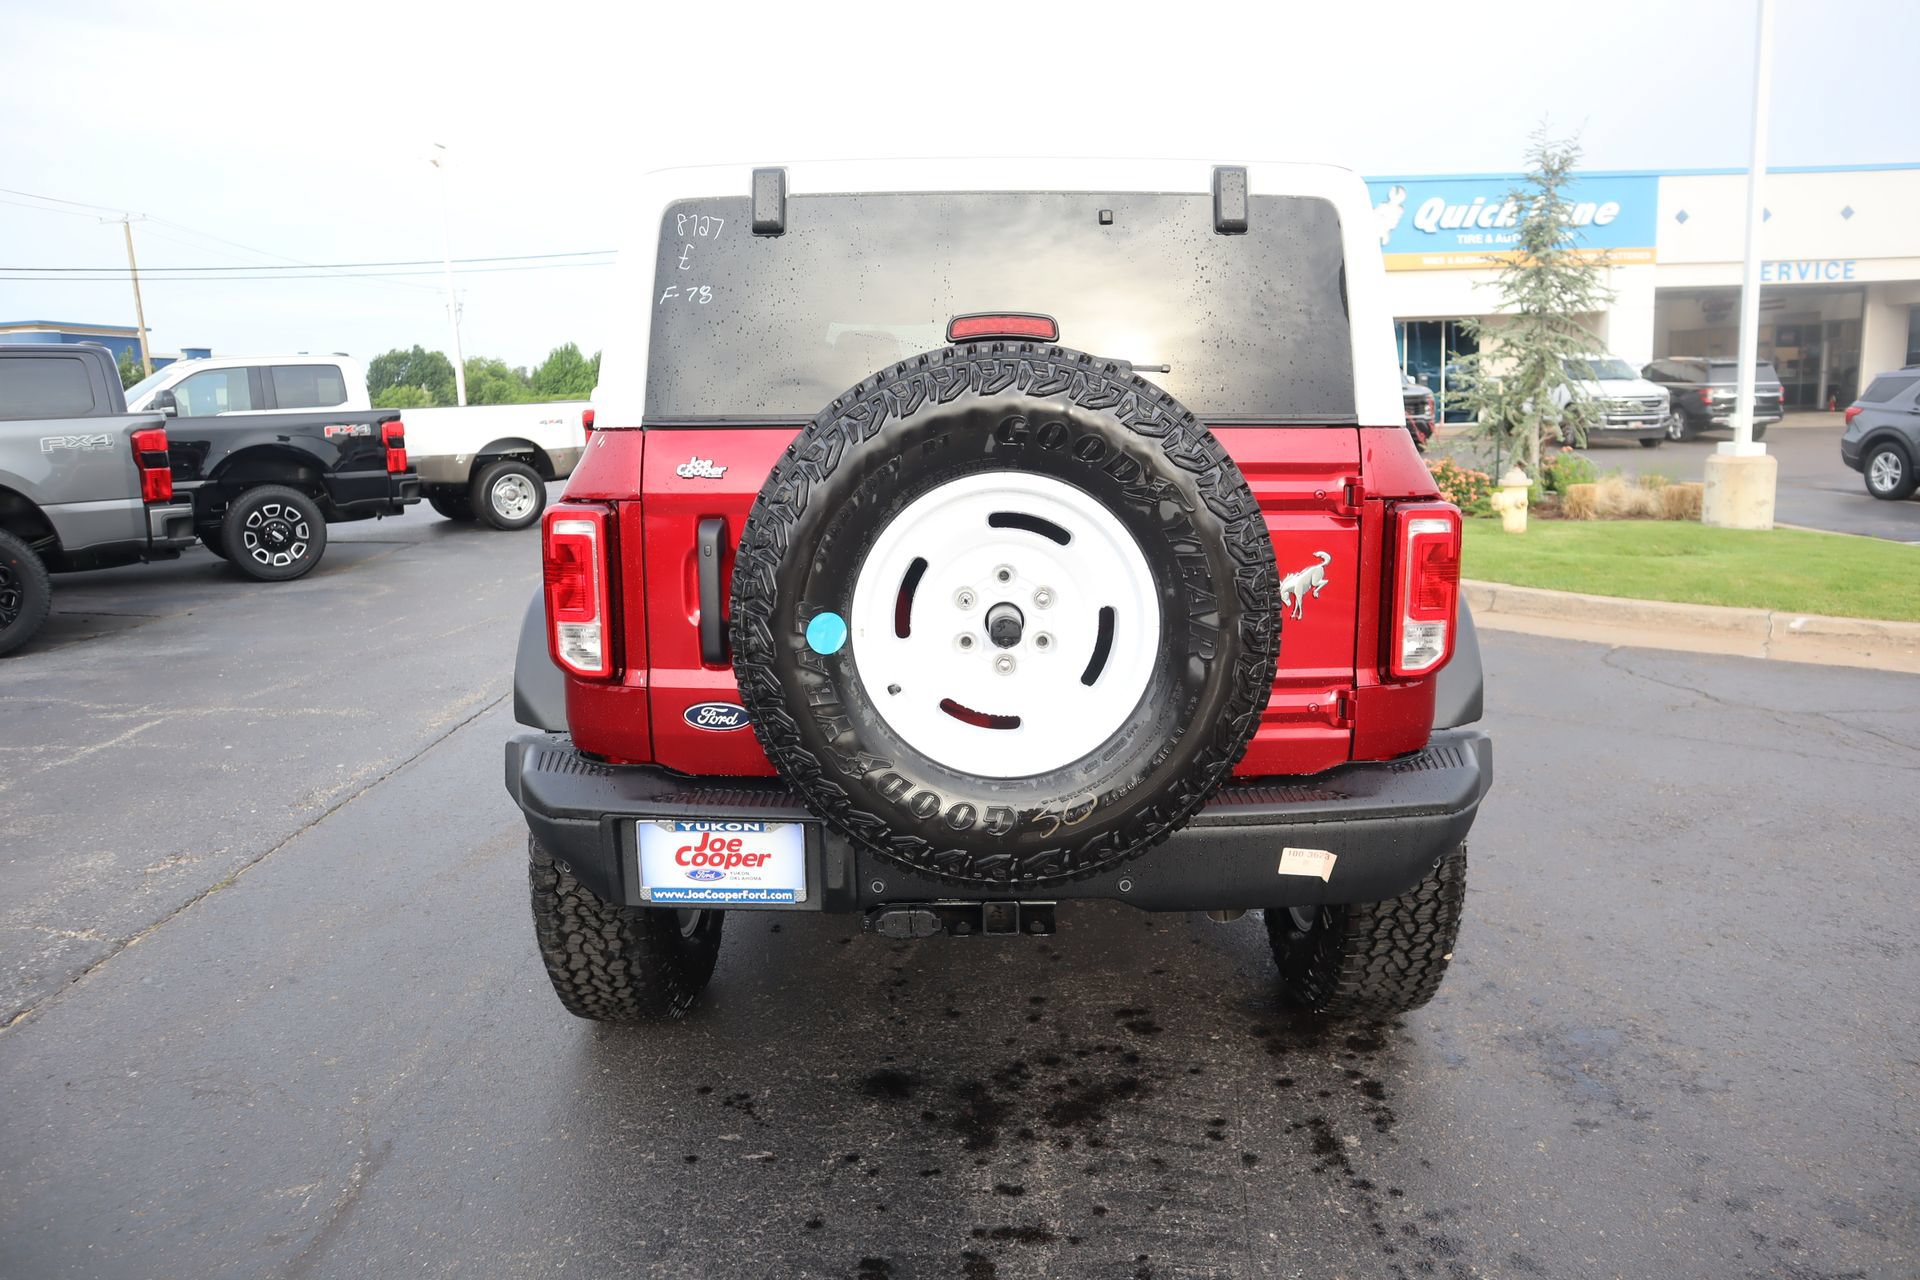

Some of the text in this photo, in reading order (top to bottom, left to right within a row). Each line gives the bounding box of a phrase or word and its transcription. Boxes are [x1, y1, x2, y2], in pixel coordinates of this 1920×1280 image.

[1414, 196, 1518, 234] Quick
[1456, 233, 1483, 244] TIRE
[1760, 260, 1857, 281] ERVICE
[323, 423, 371, 438] FX4
[40, 433, 114, 453] FX4
[676, 463, 728, 479] Cooper
[690, 456, 714, 470] Joe
[696, 706, 739, 725] Ford
[680, 822, 760, 832] YUKON
[693, 832, 743, 853] Joe
[675, 845, 771, 869] Cooper
[653, 888, 793, 902] www.JoeCooperFord.com
